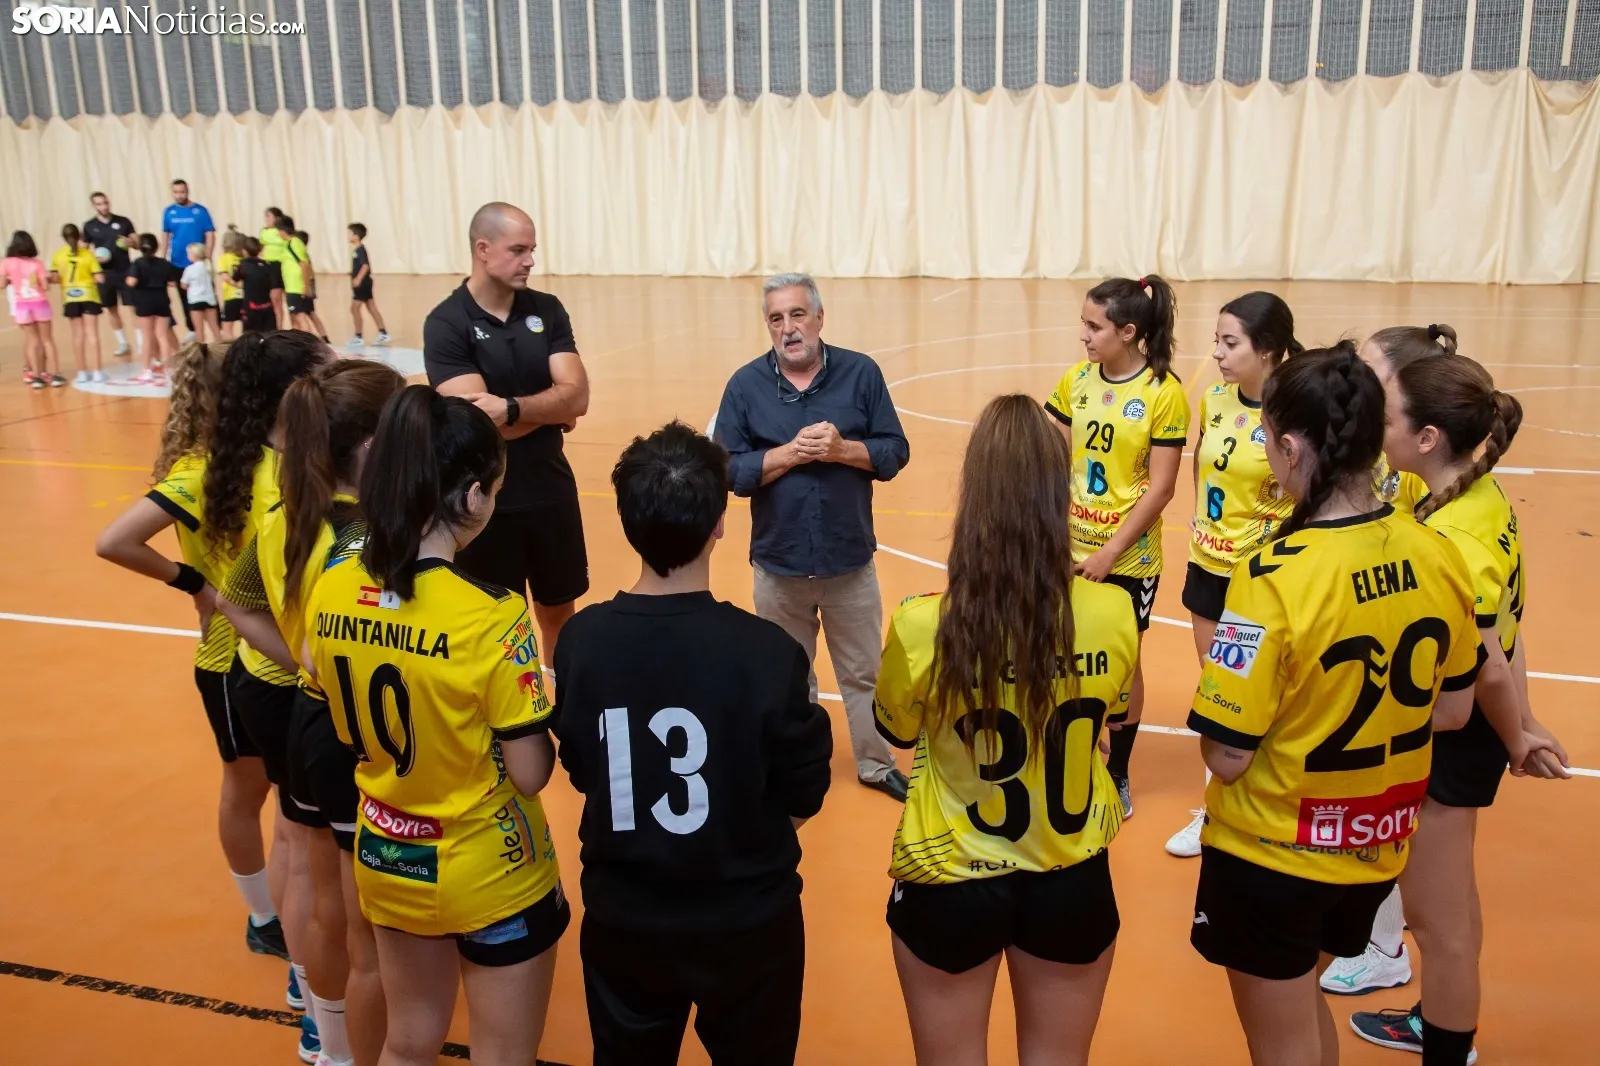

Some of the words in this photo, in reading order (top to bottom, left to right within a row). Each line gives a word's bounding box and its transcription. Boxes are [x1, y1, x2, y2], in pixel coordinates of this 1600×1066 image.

[69, 260, 77, 283] 7
[1085, 420, 1115, 453] 29
[1213, 436, 1237, 472] 3
[1069, 522, 1114, 538] eligeSori
[1351, 559, 1419, 604] ELENA
[317, 612, 450, 659] QUINTANILLA
[1212, 693, 1243, 714] Soria
[1304, 616, 1451, 773] 29
[333, 655, 416, 777] 10
[599, 707, 709, 835] 13
[953, 696, 1107, 843] 30
[377, 809, 437, 837] Soria
[1349, 806, 1415, 845] Sori
[361, 849, 381, 867] Caja
[397, 862, 429, 875] Soria
